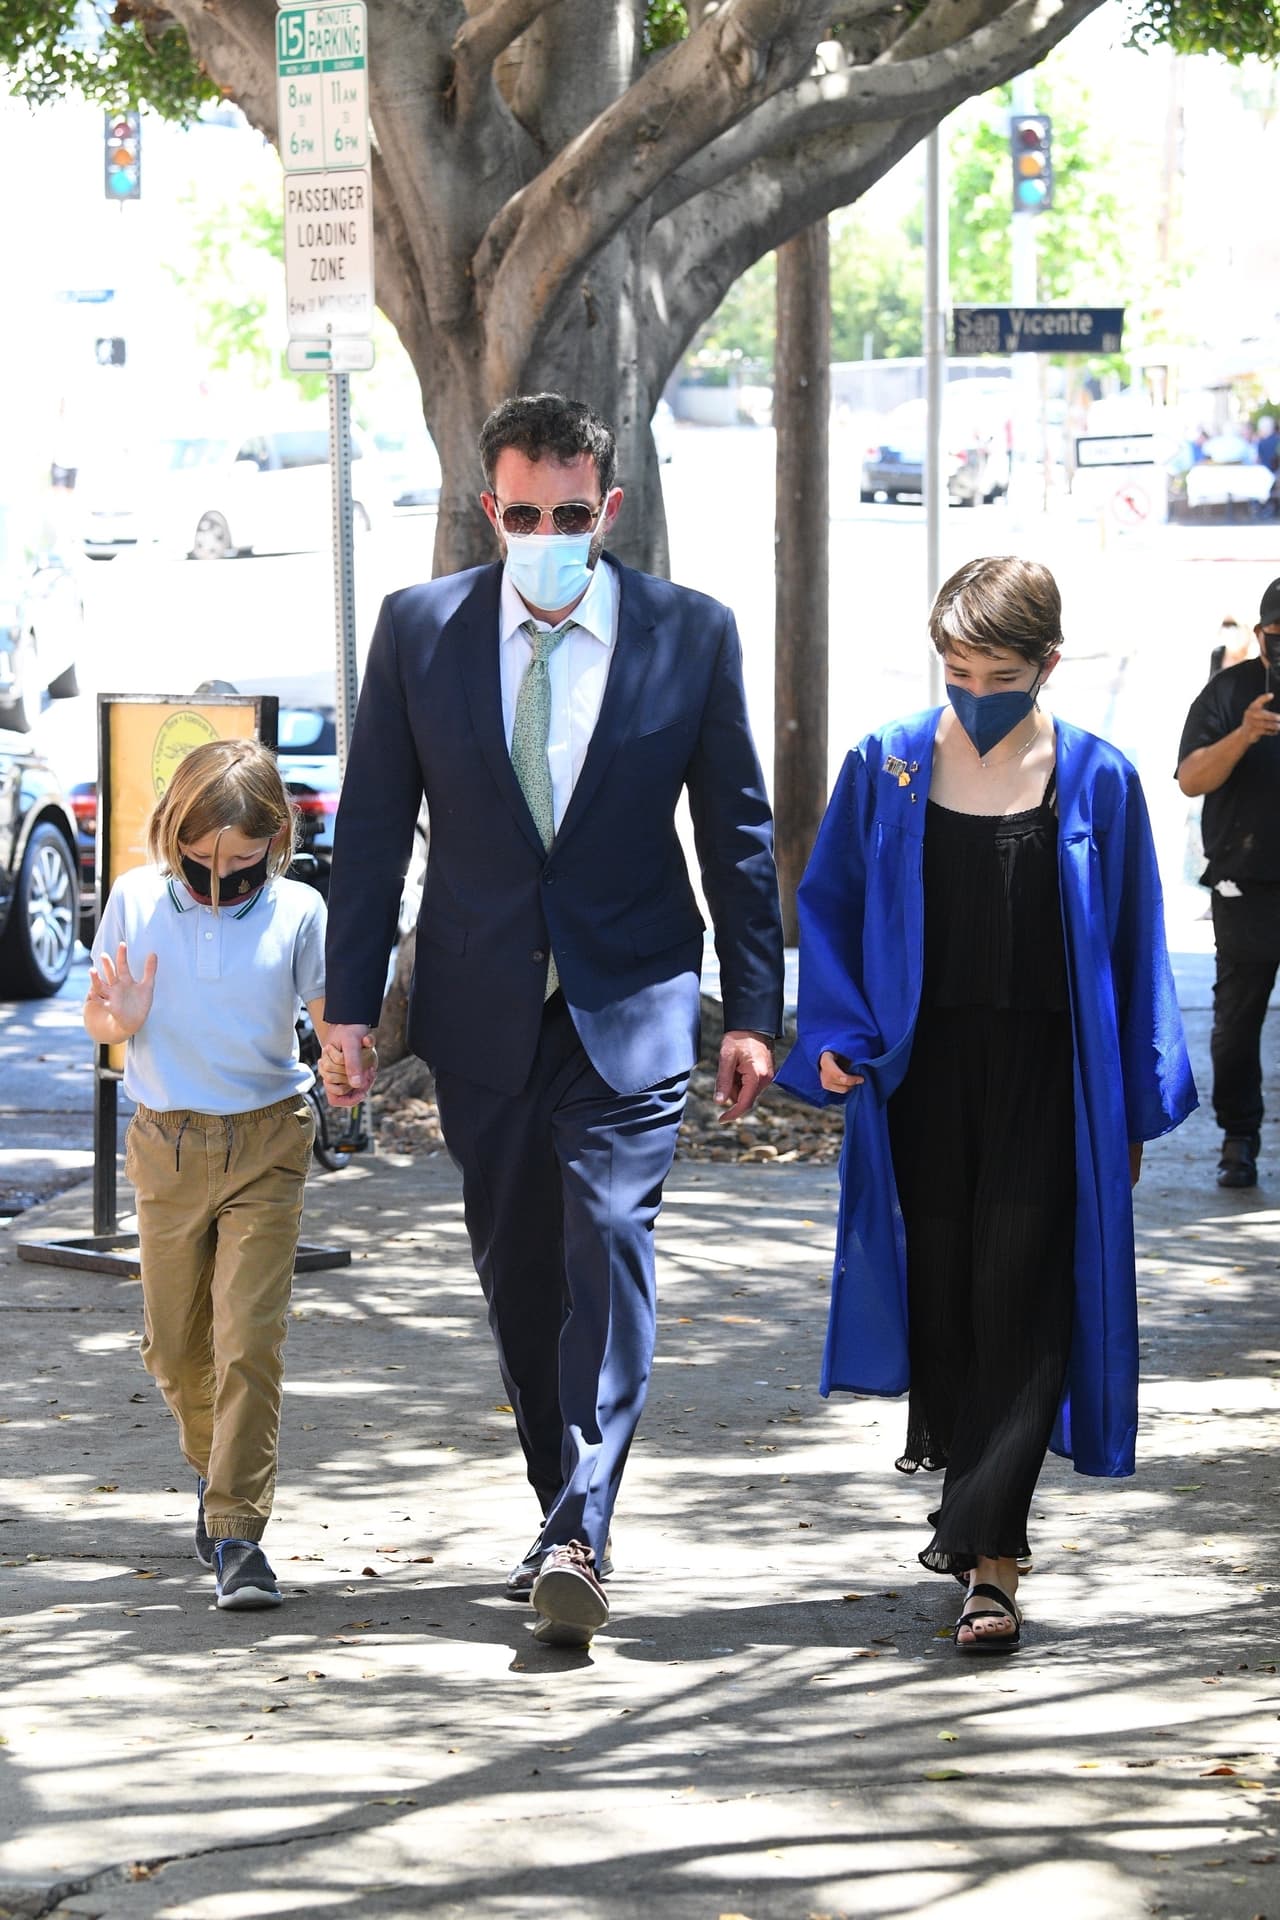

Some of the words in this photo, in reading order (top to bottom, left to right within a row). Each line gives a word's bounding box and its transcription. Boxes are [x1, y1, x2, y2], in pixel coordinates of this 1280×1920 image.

[316, 9, 352, 25] MINUTE
[279, 15, 304, 57] 15
[308, 26, 361, 59] PARKING
[288, 186, 365, 214] PASSENGER
[297, 221, 357, 248] LOADING
[310, 257, 346, 282] ZONE
[957, 309, 999, 336] San
[1008, 309, 1094, 336] Vicente
